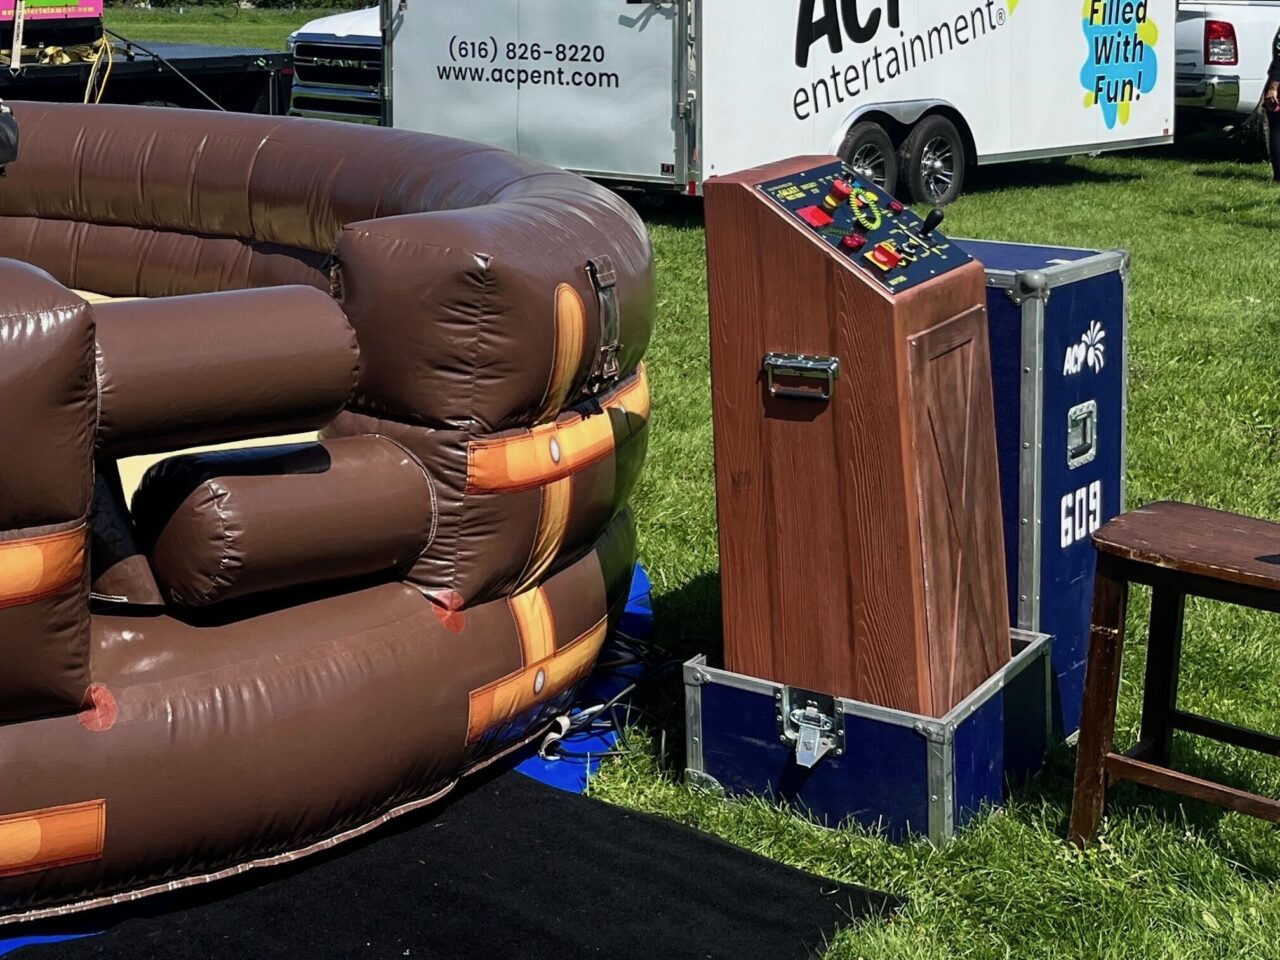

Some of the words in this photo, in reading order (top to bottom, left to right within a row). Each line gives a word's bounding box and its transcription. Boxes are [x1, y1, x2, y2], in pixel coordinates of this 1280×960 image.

[449, 35, 498, 63] (616)
[506, 42, 605, 63] 826-8220
[1094, 30, 1144, 65] With
[437, 65, 619, 90] www.acpent.com
[1093, 71, 1142, 105] Fun!
[1063, 342, 1087, 376] ACP
[1060, 480, 1101, 548] 609
